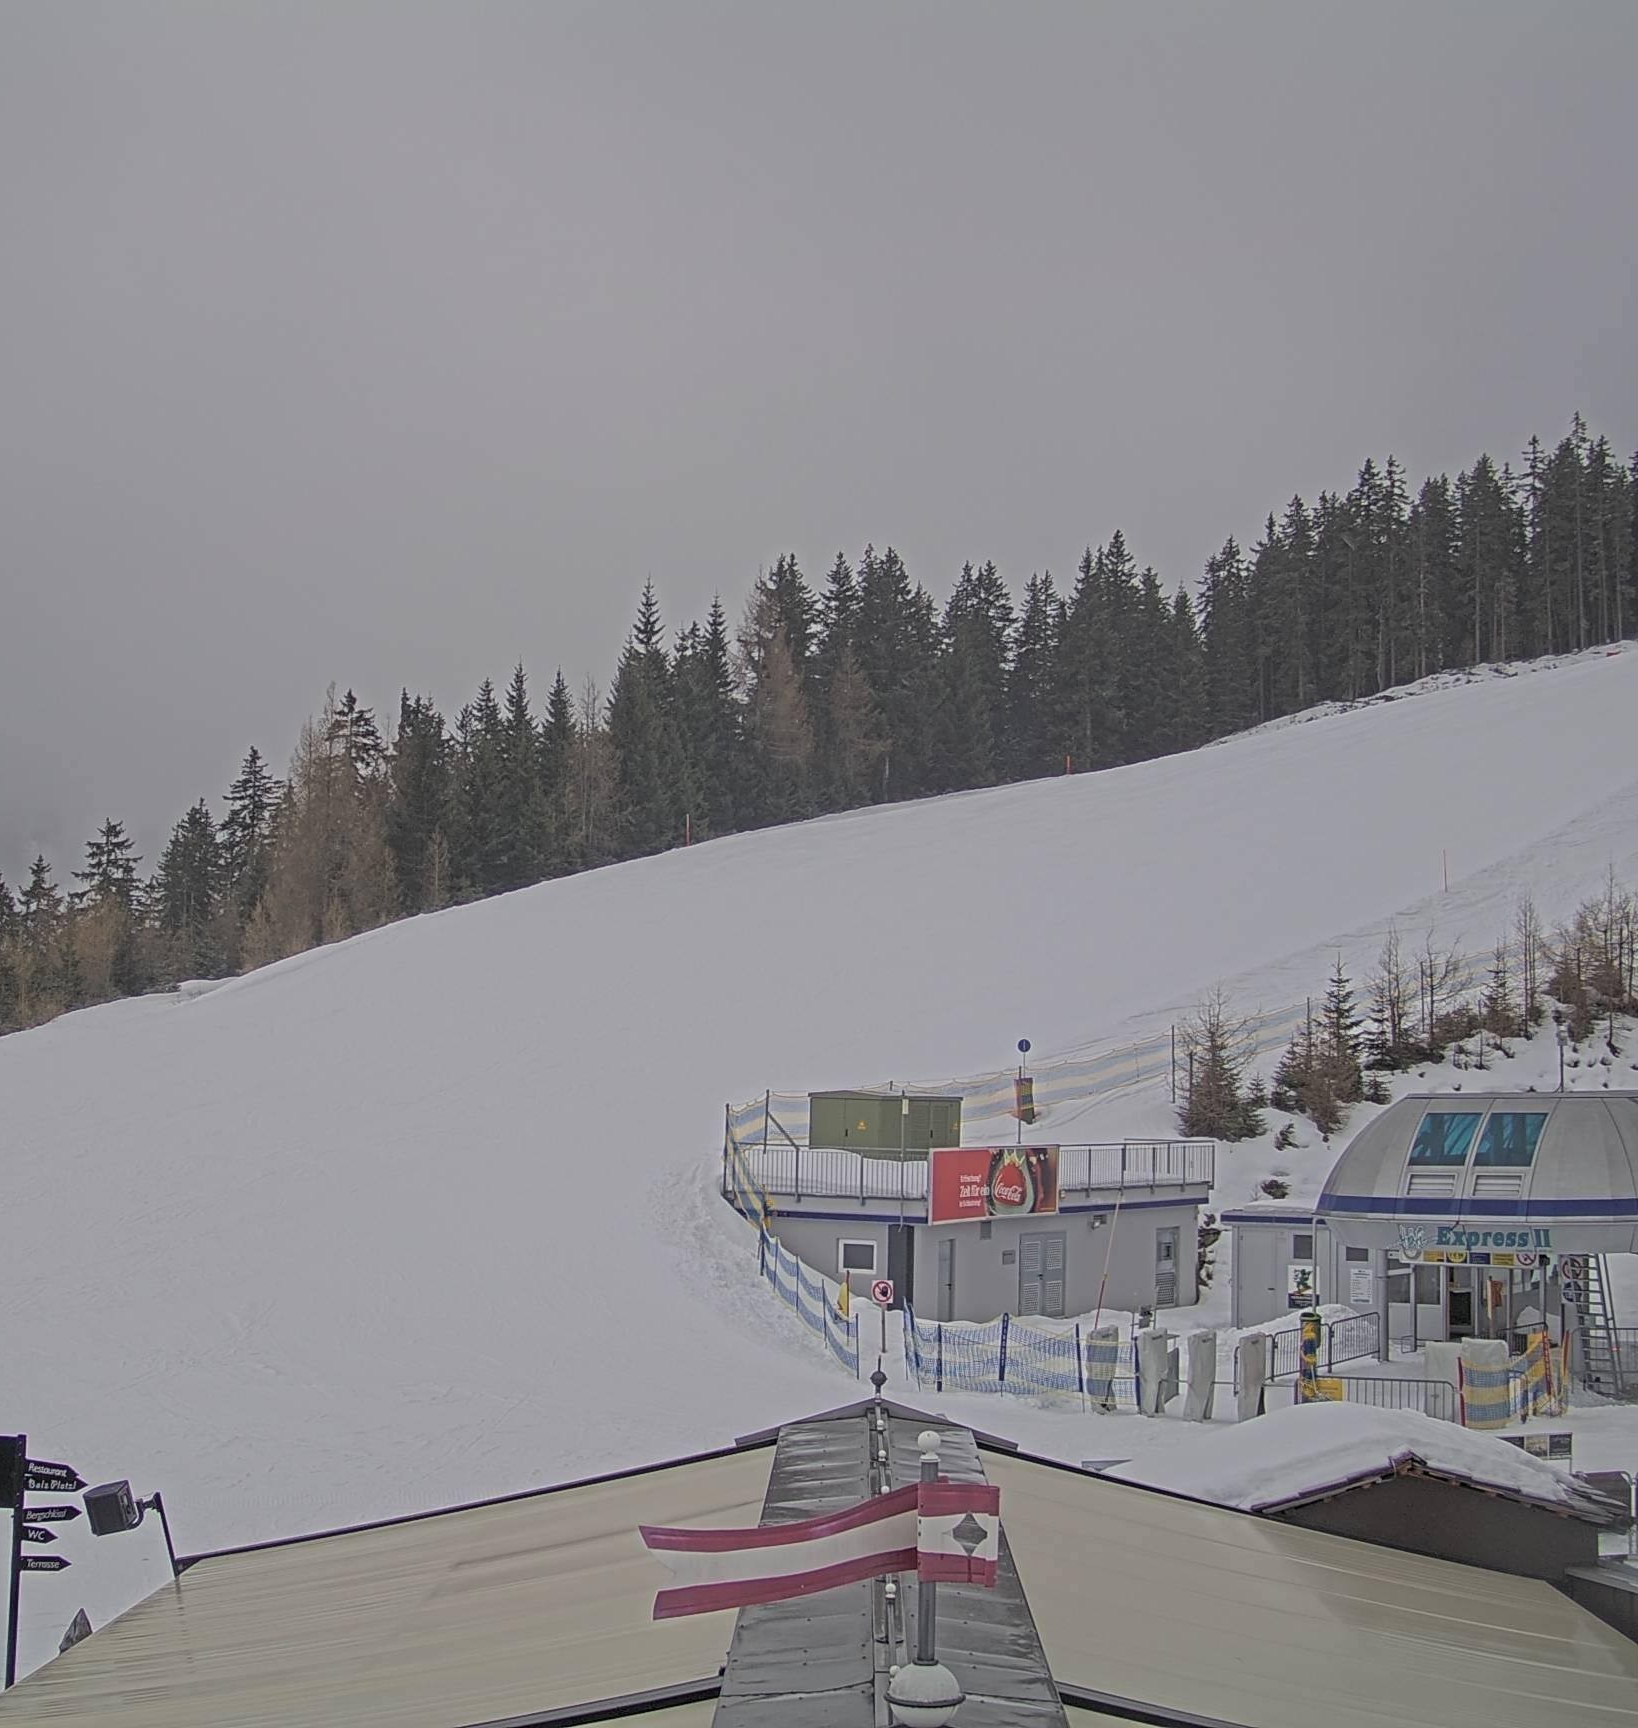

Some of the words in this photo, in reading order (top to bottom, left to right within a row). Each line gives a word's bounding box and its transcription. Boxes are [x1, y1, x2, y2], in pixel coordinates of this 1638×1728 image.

[1436, 1226, 1530, 1250] Express
[28, 1463, 67, 1477] Restaurant
[28, 1529, 46, 1540] WC
[26, 1558, 60, 1569] Terrasse
